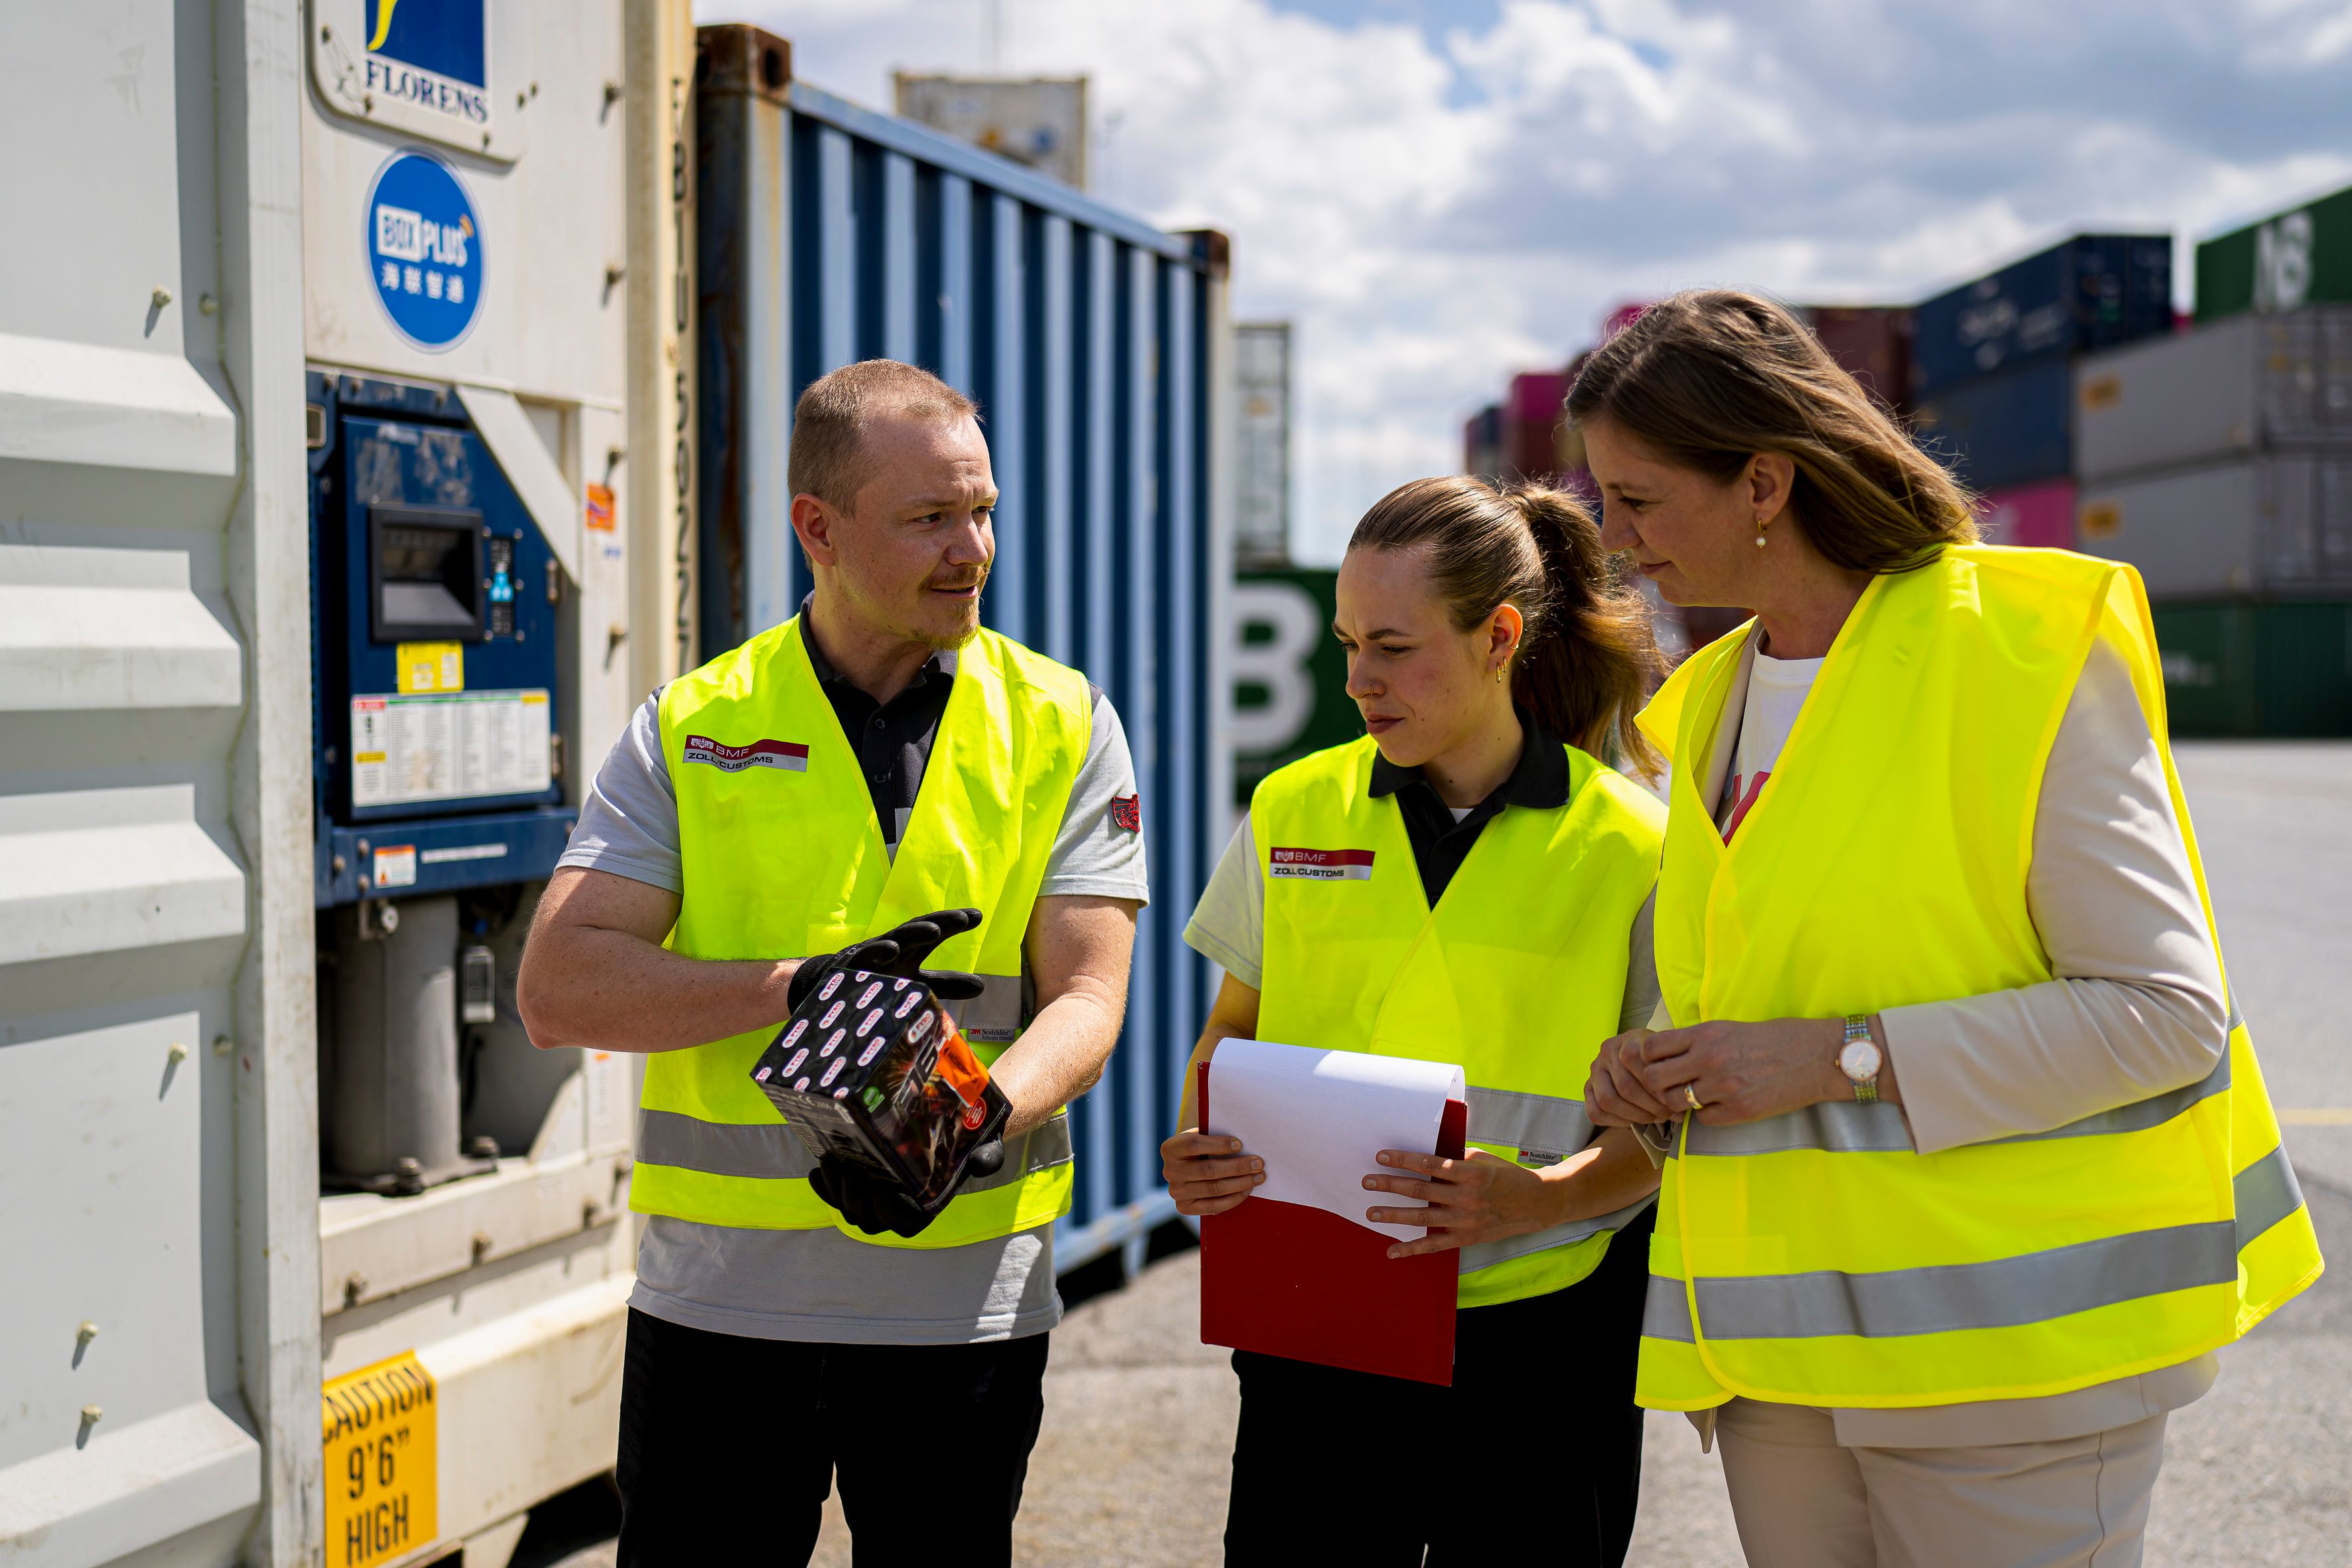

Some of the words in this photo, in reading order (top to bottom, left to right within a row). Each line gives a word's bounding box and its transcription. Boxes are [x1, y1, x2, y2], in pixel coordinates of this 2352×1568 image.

[366, 59, 488, 123] FLORENS
[716, 745, 749, 757] BMF
[688, 753, 773, 769] ZOLL/CUSTOMS
[1295, 852, 1327, 863] BMF
[1274, 868, 1344, 878] ZOLL/CUSTOMS
[827, 974, 840, 990] PYRO
[864, 983, 878, 998] PYRO
[827, 1002, 841, 1018] PYRO
[865, 1010, 878, 1026] PYRO
[791, 1021, 804, 1038] PYRO
[828, 1030, 842, 1046] PYRO
[791, 1050, 805, 1066] PYRO
[323, 1364, 431, 1445] AUTION
[346, 1494, 409, 1567] HIGH
